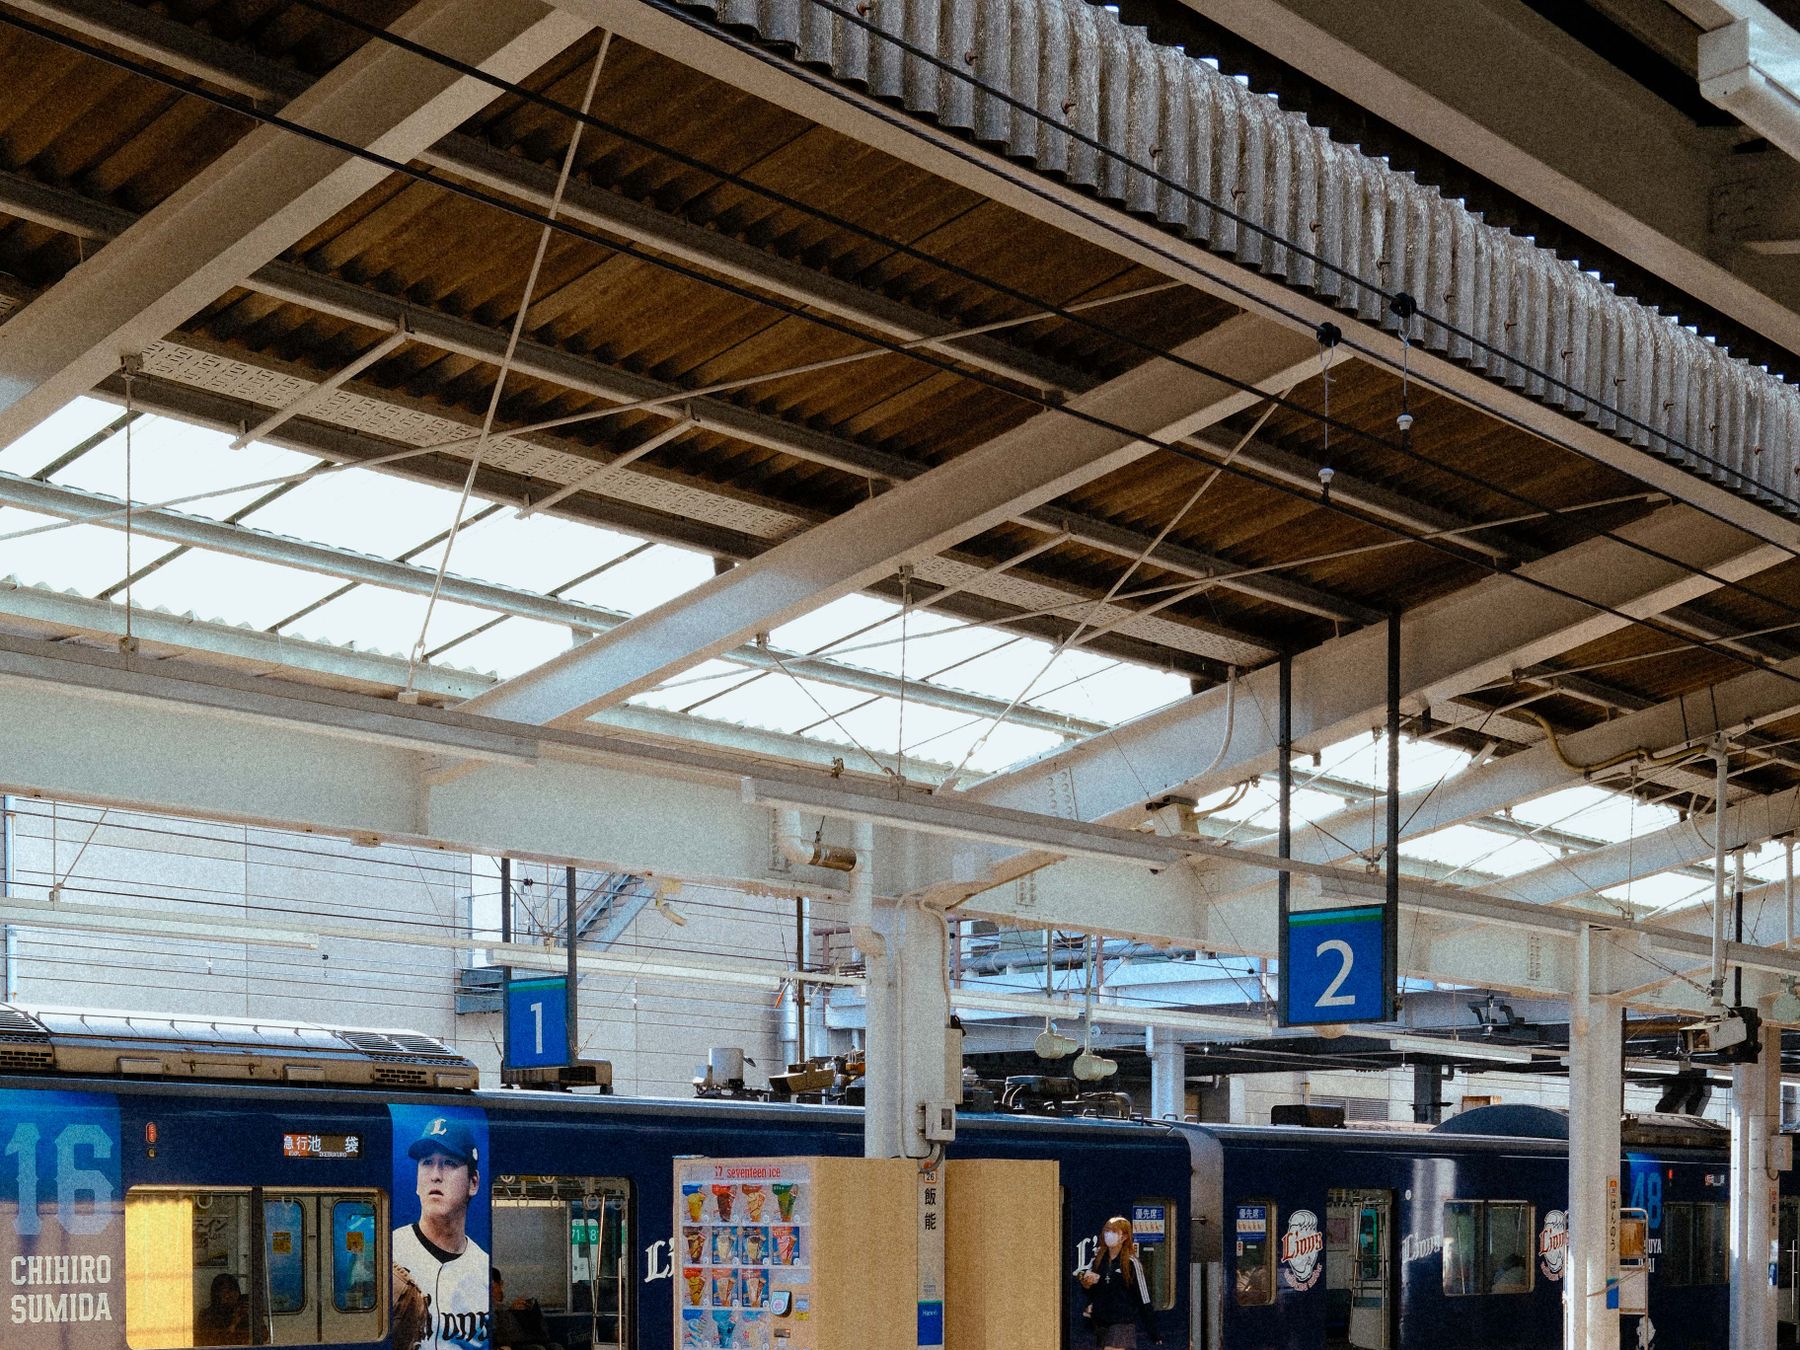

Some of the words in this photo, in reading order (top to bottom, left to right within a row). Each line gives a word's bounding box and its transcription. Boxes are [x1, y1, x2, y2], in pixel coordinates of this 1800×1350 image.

[1315, 939, 1356, 1007] 2
[530, 1002, 543, 1054] 1
[430, 1118, 447, 1135] L
[284, 1135, 307, 1150] 急行
[308, 1135, 359, 1153] 池袋
[5, 1122, 114, 1235] 16
[727, 1167, 767, 1178] seventeen
[768, 1164, 781, 1178] ice
[924, 1187, 937, 1230] 飯能
[1630, 1172, 1662, 1229] 48
[1282, 1231, 1323, 1262] Lions
[1402, 1232, 1441, 1262] Lions
[10, 1254, 112, 1286] CHIHIRO
[10, 1292, 113, 1324] SUMIDA
